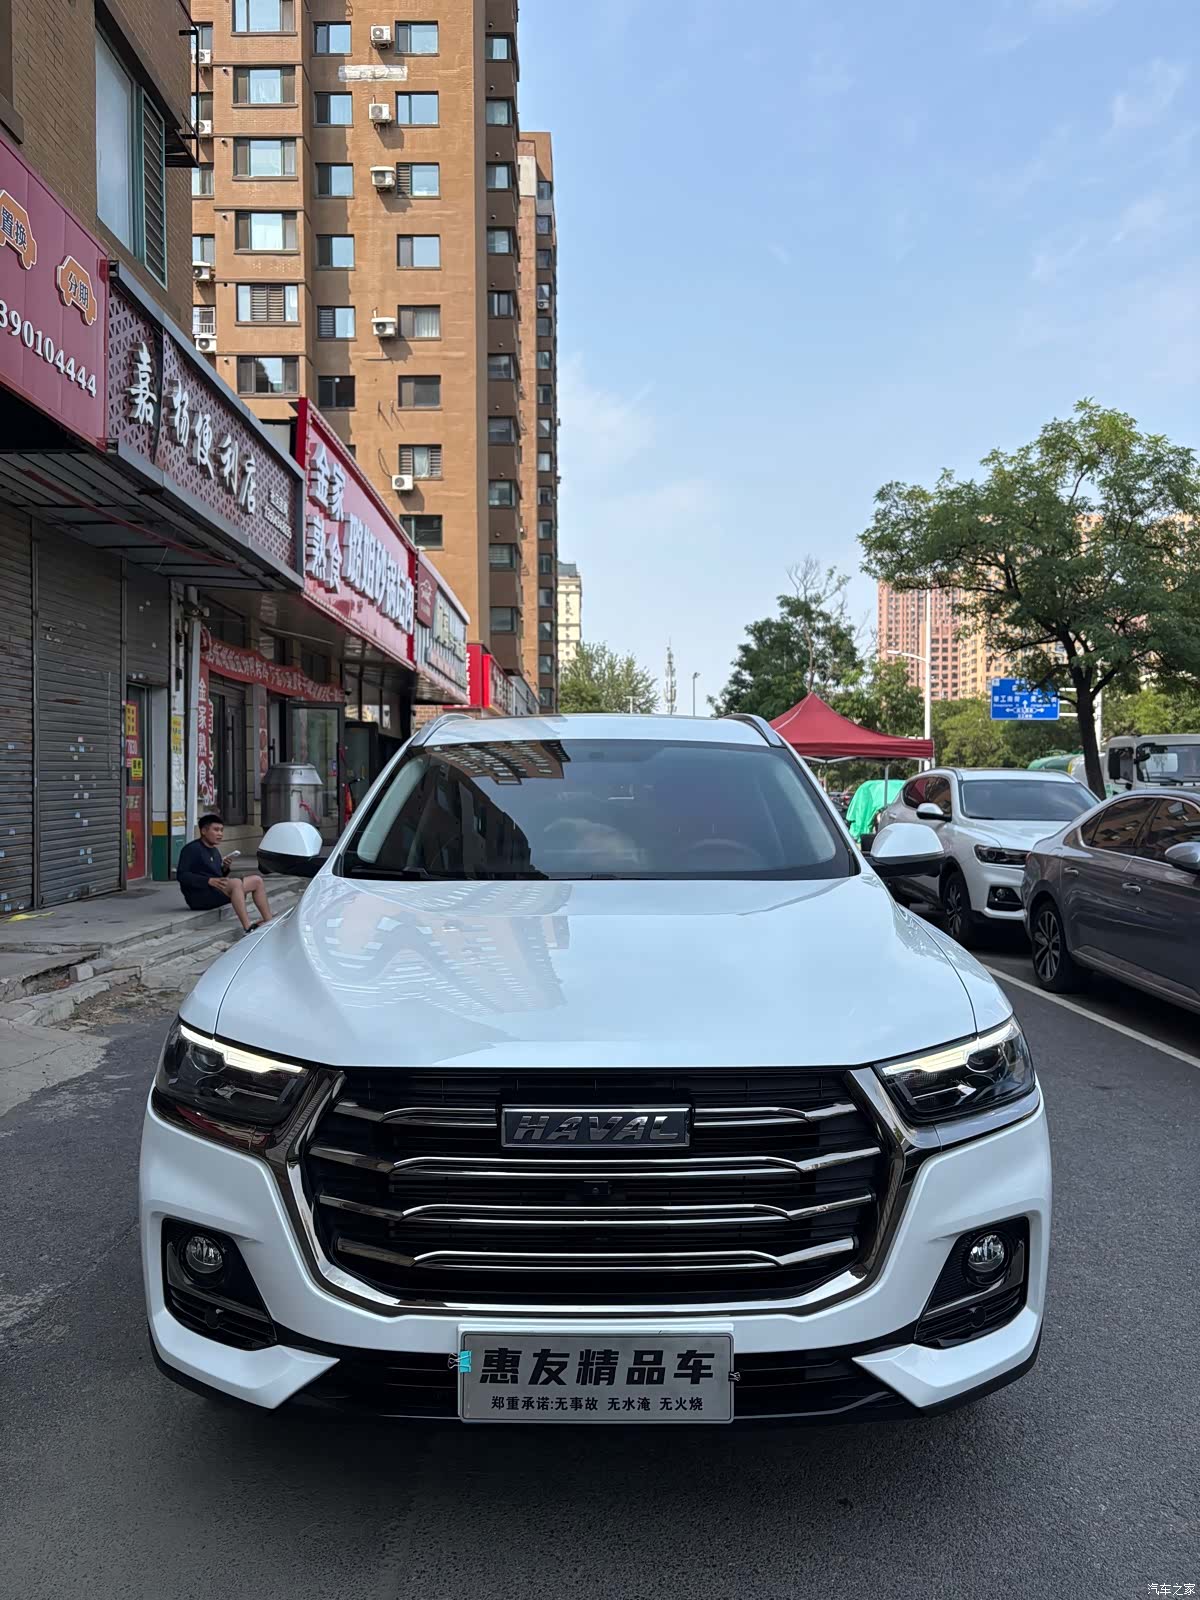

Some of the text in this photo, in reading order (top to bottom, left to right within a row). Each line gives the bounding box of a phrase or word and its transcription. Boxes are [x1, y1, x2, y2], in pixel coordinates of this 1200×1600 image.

[1, 206, 28, 252] 置换
[312, 442, 346, 521] 金家
[308, 514, 341, 594] 熟食
[513, 1115, 679, 1141] HAVAL
[479, 1347, 713, 1386] 惠友精品车
[491, 1396, 703, 1411] 郑重承诺:无事故 无水淹 无火烧
